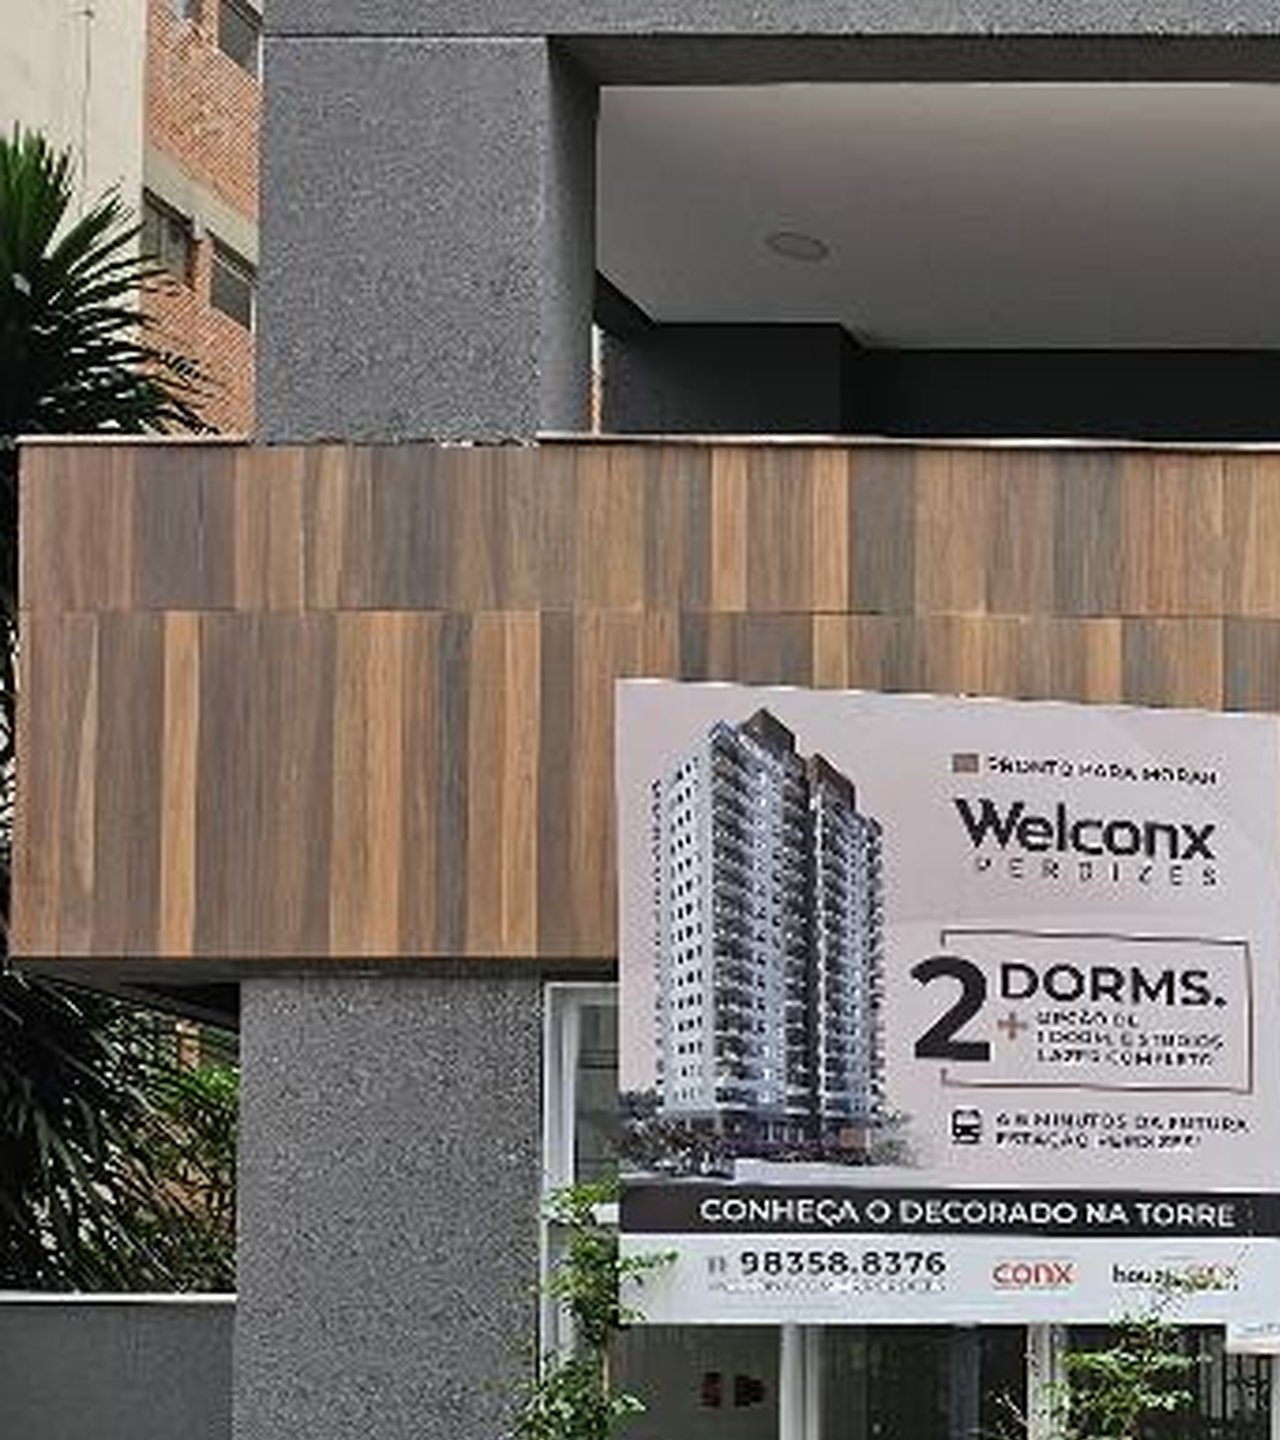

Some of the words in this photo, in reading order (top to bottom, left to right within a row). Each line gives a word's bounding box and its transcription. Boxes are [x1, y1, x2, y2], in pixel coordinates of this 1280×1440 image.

[953, 798, 1216, 860] Welconx
[976, 857, 1216, 886] PERDIZES
[910, 956, 990, 1061] 2
[1000, 962, 1228, 1009] DORMS.
[700, 1199, 860, 1227] CONHEÇA
[866, 1200, 891, 1224] O
[900, 1200, 1078, 1225] DECORADO
[1086, 1202, 1129, 1225] NA
[1134, 1202, 1236, 1227] TORRE
[740, 1251, 947, 1276] 98358.8376
[993, 1262, 1075, 1286] conx
